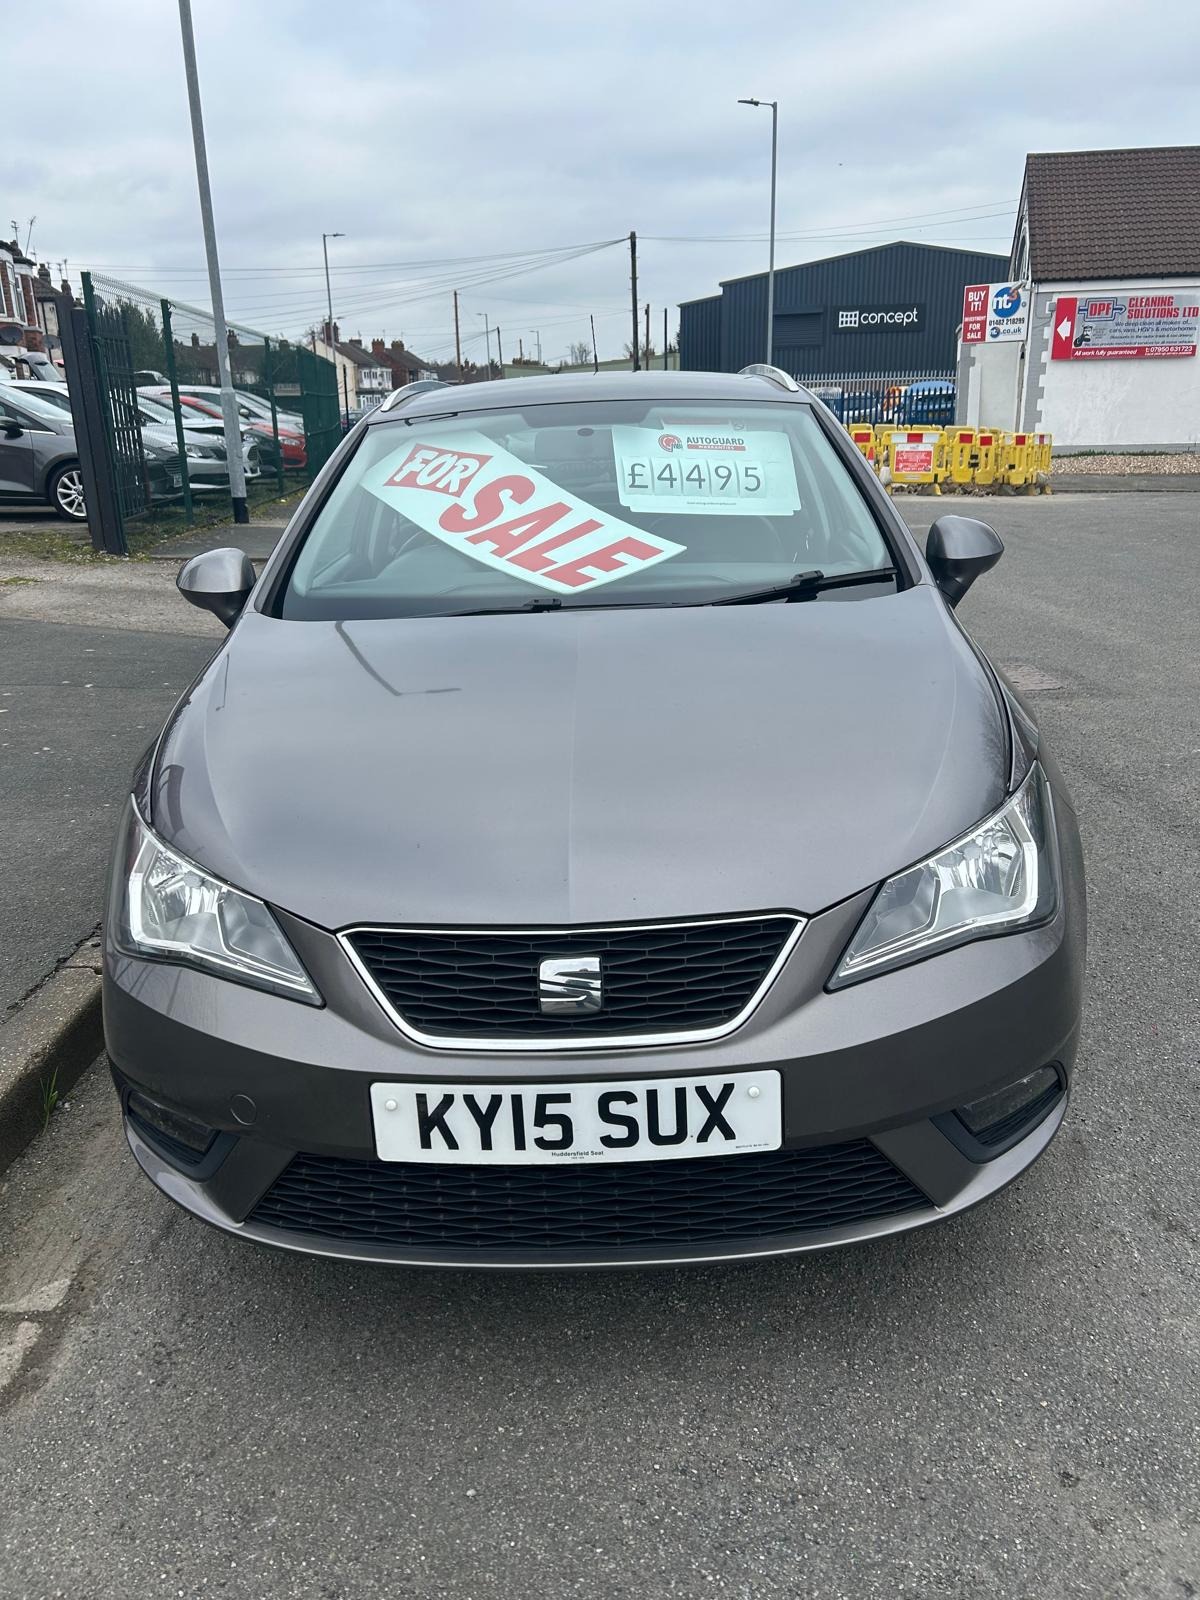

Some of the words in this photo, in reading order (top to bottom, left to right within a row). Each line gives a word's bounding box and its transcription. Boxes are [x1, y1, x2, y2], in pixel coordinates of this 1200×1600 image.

[968, 290, 986, 302] BUY
[1128, 296, 1174, 308] CLEANING
[971, 301, 982, 311] IT!
[1089, 302, 1112, 317] DPF
[860, 307, 918, 327] concept
[1127, 307, 1180, 319] SOLUTIONS
[1182, 306, 1199, 318] LTD
[969, 323, 981, 331] FOR
[966, 332, 982, 340] SALE
[1106, 348, 1138, 357] guaranteed
[686, 436, 745, 446] AUTOGUARD
[394, 449, 481, 493] FOR
[627, 463, 761, 492] £4495
[438, 474, 665, 588] SALE
[415, 1093, 574, 1151] KY15
[597, 1082, 737, 1149] SUX
[551, 1150, 590, 1158] Huddersfield
